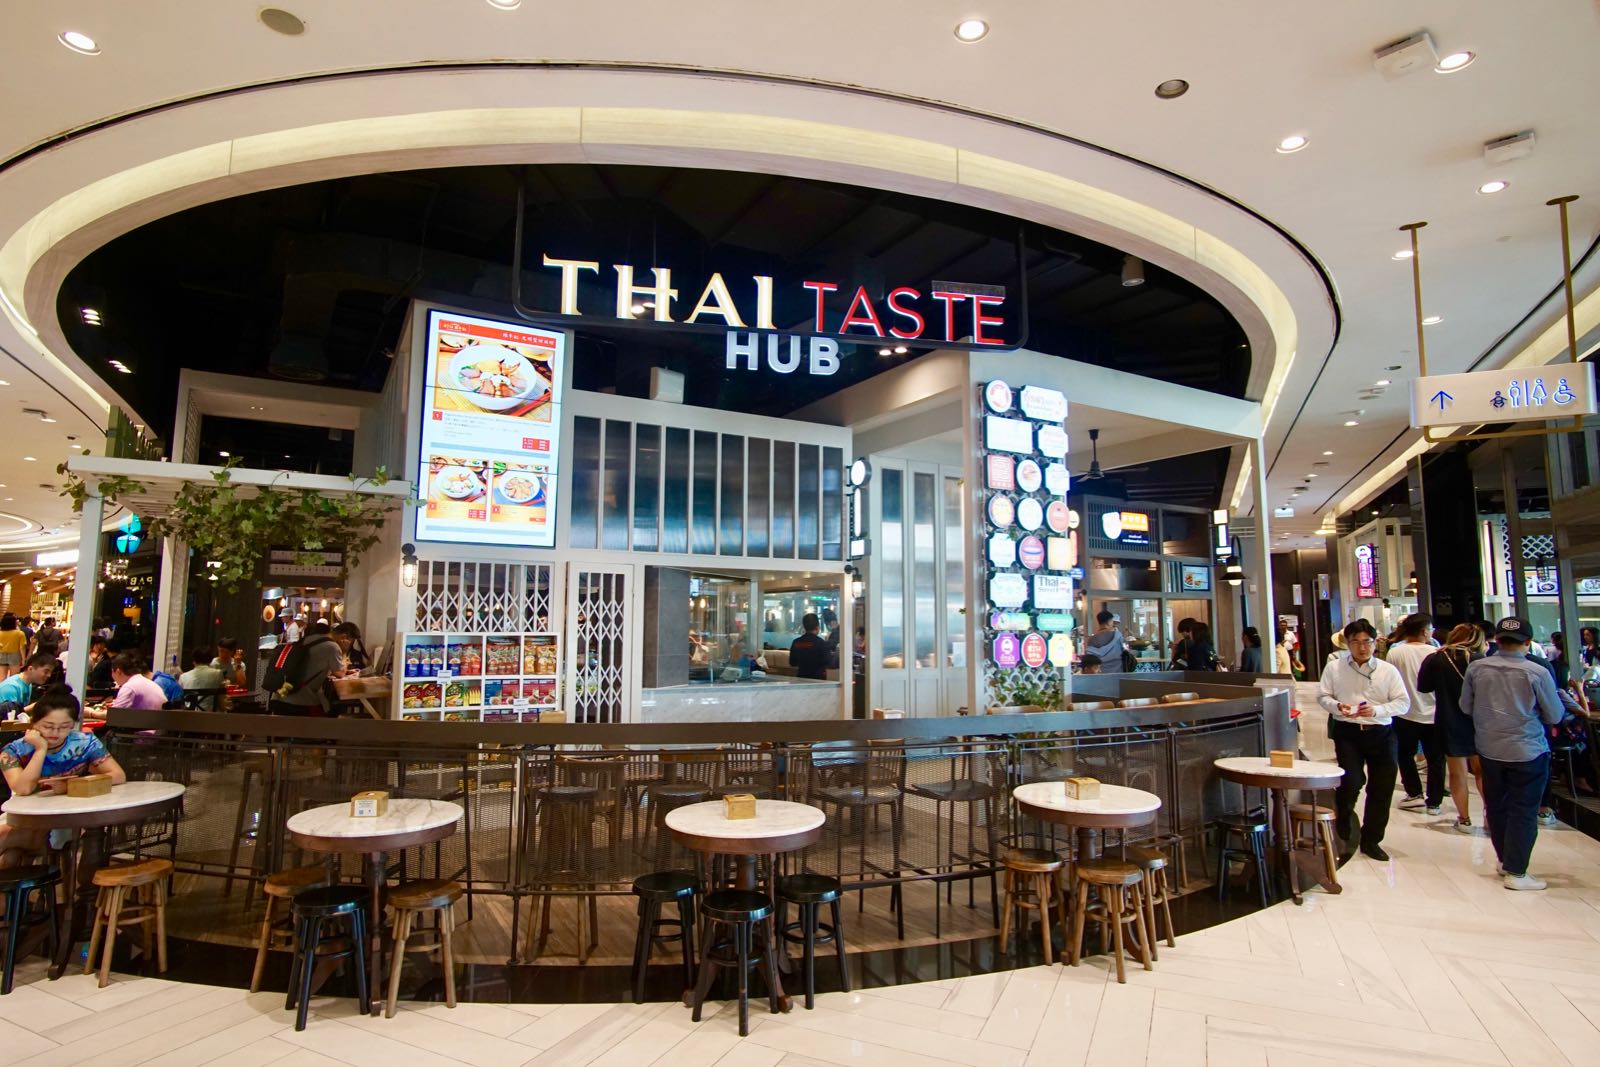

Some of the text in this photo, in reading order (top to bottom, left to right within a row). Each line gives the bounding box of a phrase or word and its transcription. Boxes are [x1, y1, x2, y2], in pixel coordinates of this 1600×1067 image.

[542, 253, 1006, 345] THAI TASTE
[725, 330, 841, 376] HUB
